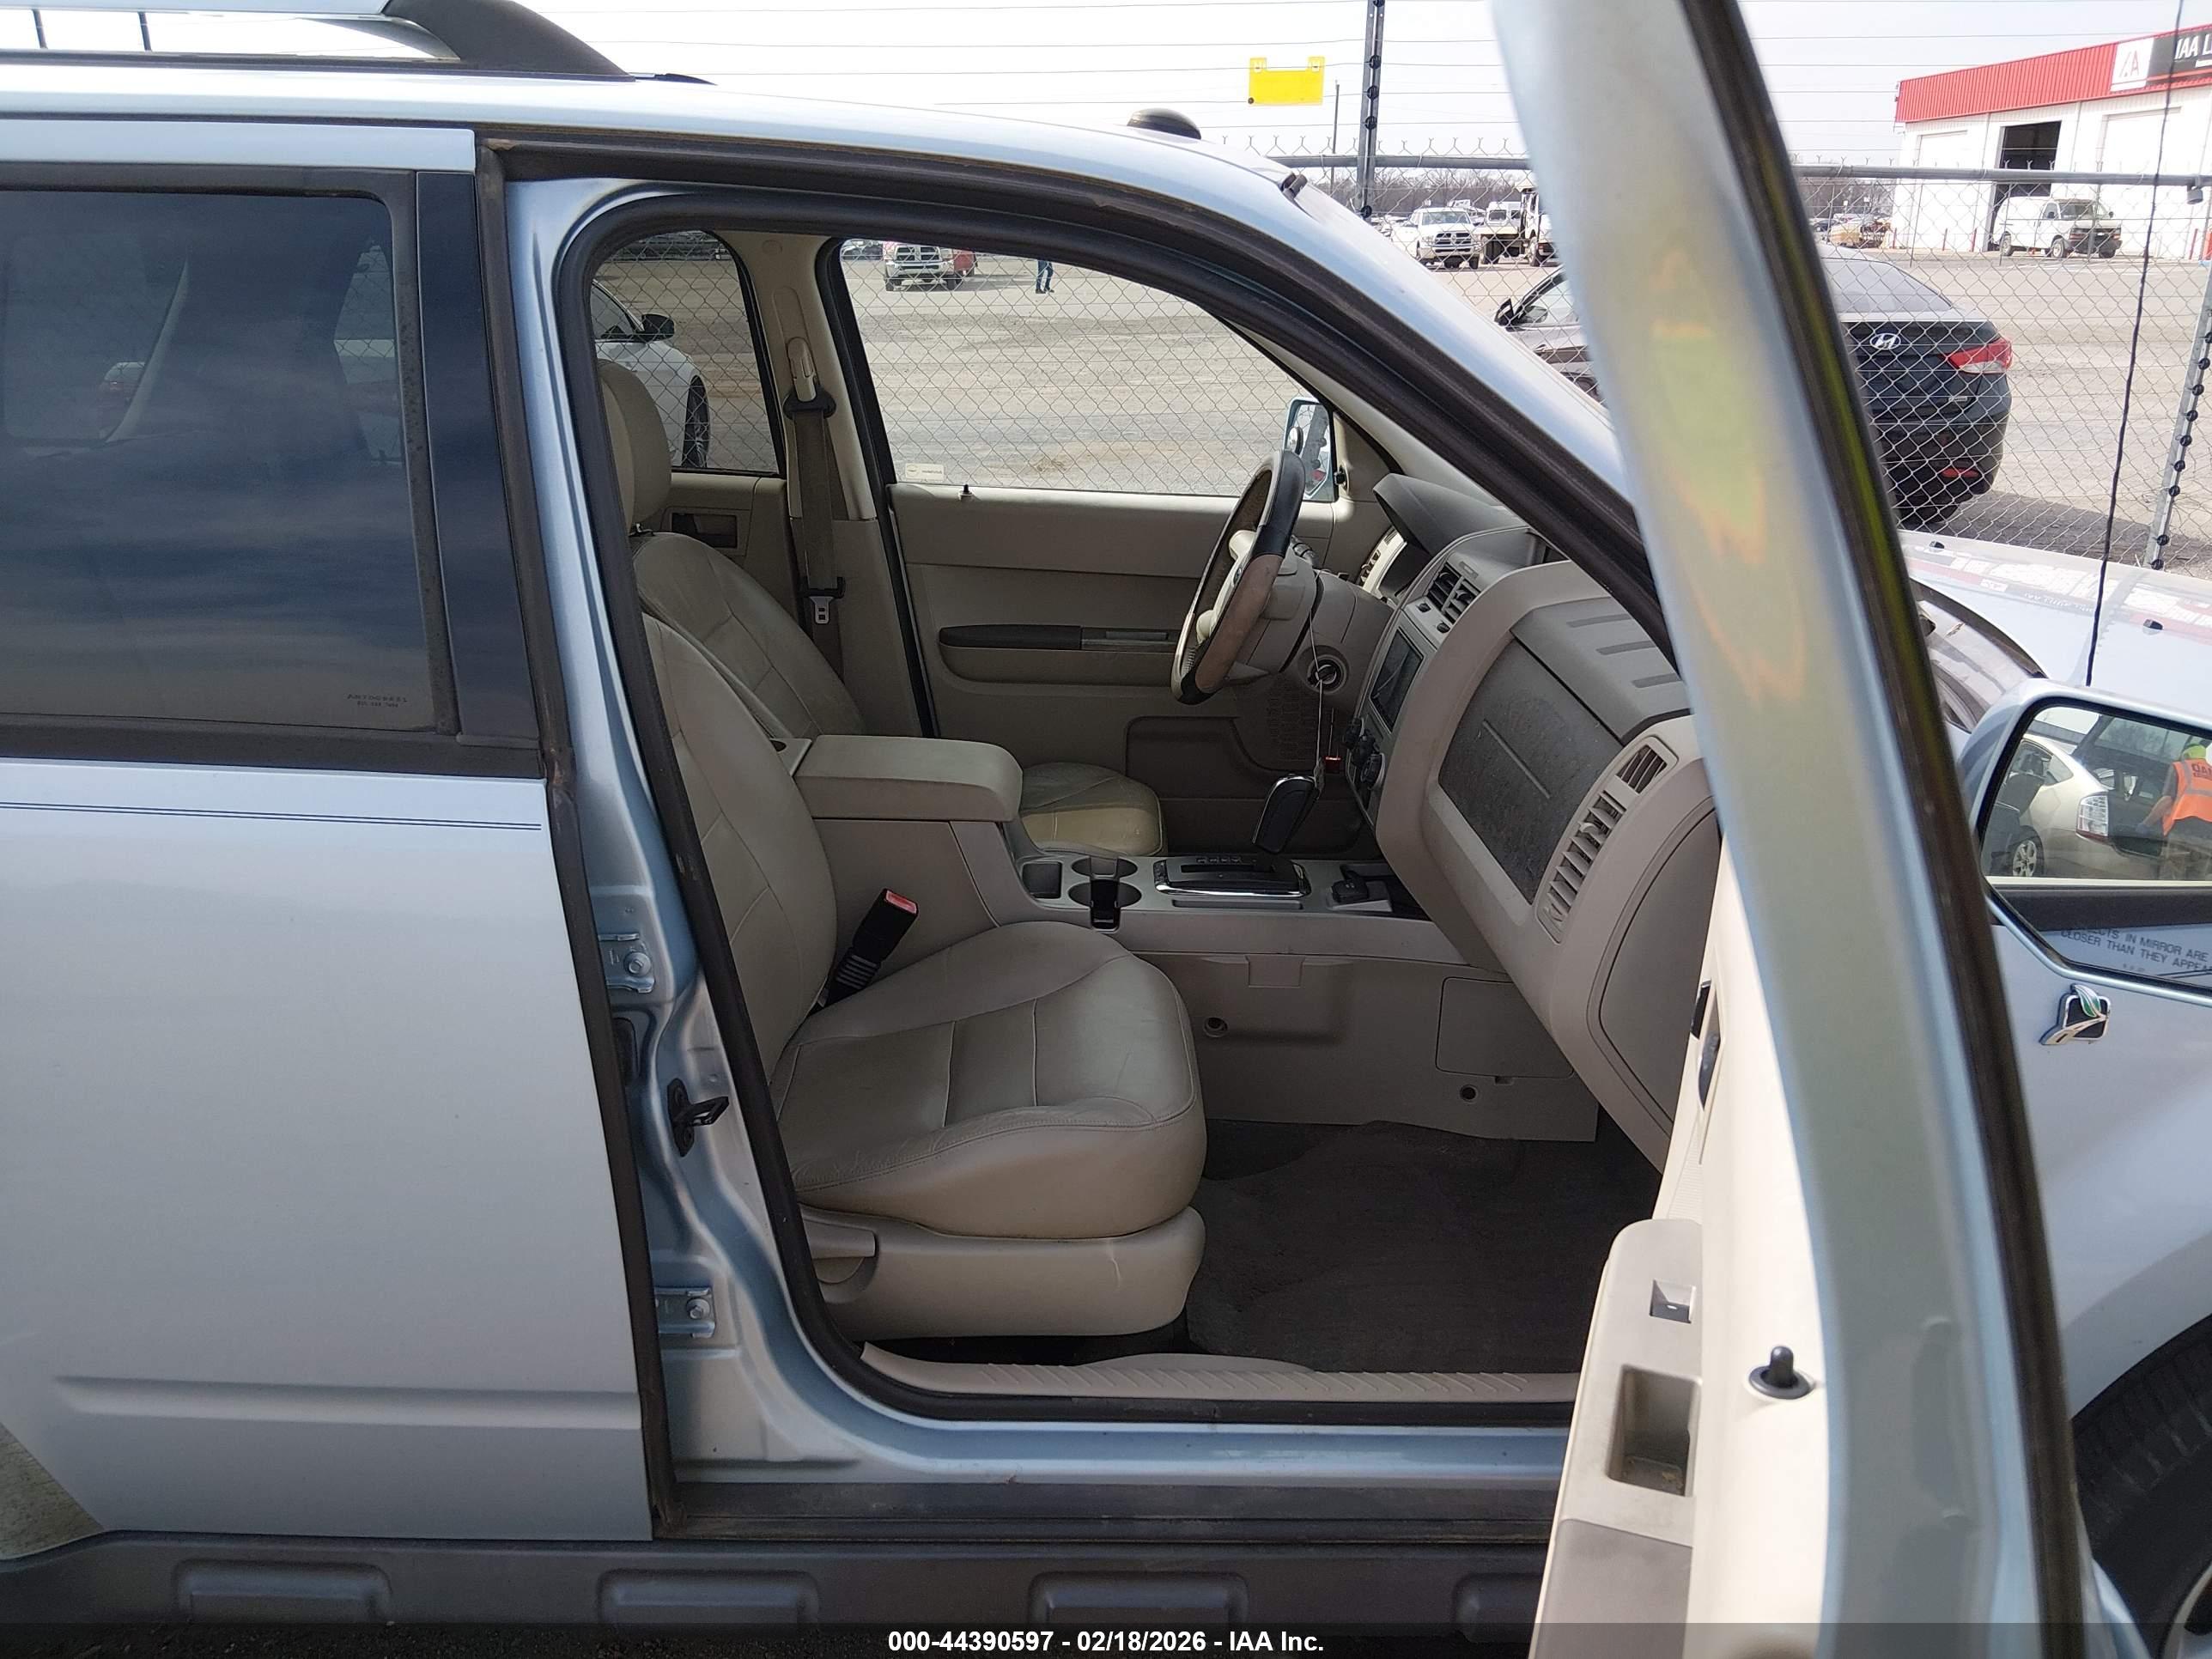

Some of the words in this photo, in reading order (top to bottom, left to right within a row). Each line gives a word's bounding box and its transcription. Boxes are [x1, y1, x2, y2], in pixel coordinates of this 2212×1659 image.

[2174, 36, 2199, 59] IAA
[2202, 33, 2212, 55] L
[2106, 940, 2136, 956] THAN
[2140, 948, 2168, 963] THEY
[2125, 933, 2136, 945] IN
[2139, 937, 2182, 956] MIRROR
[2185, 949, 2210, 963] ARE
